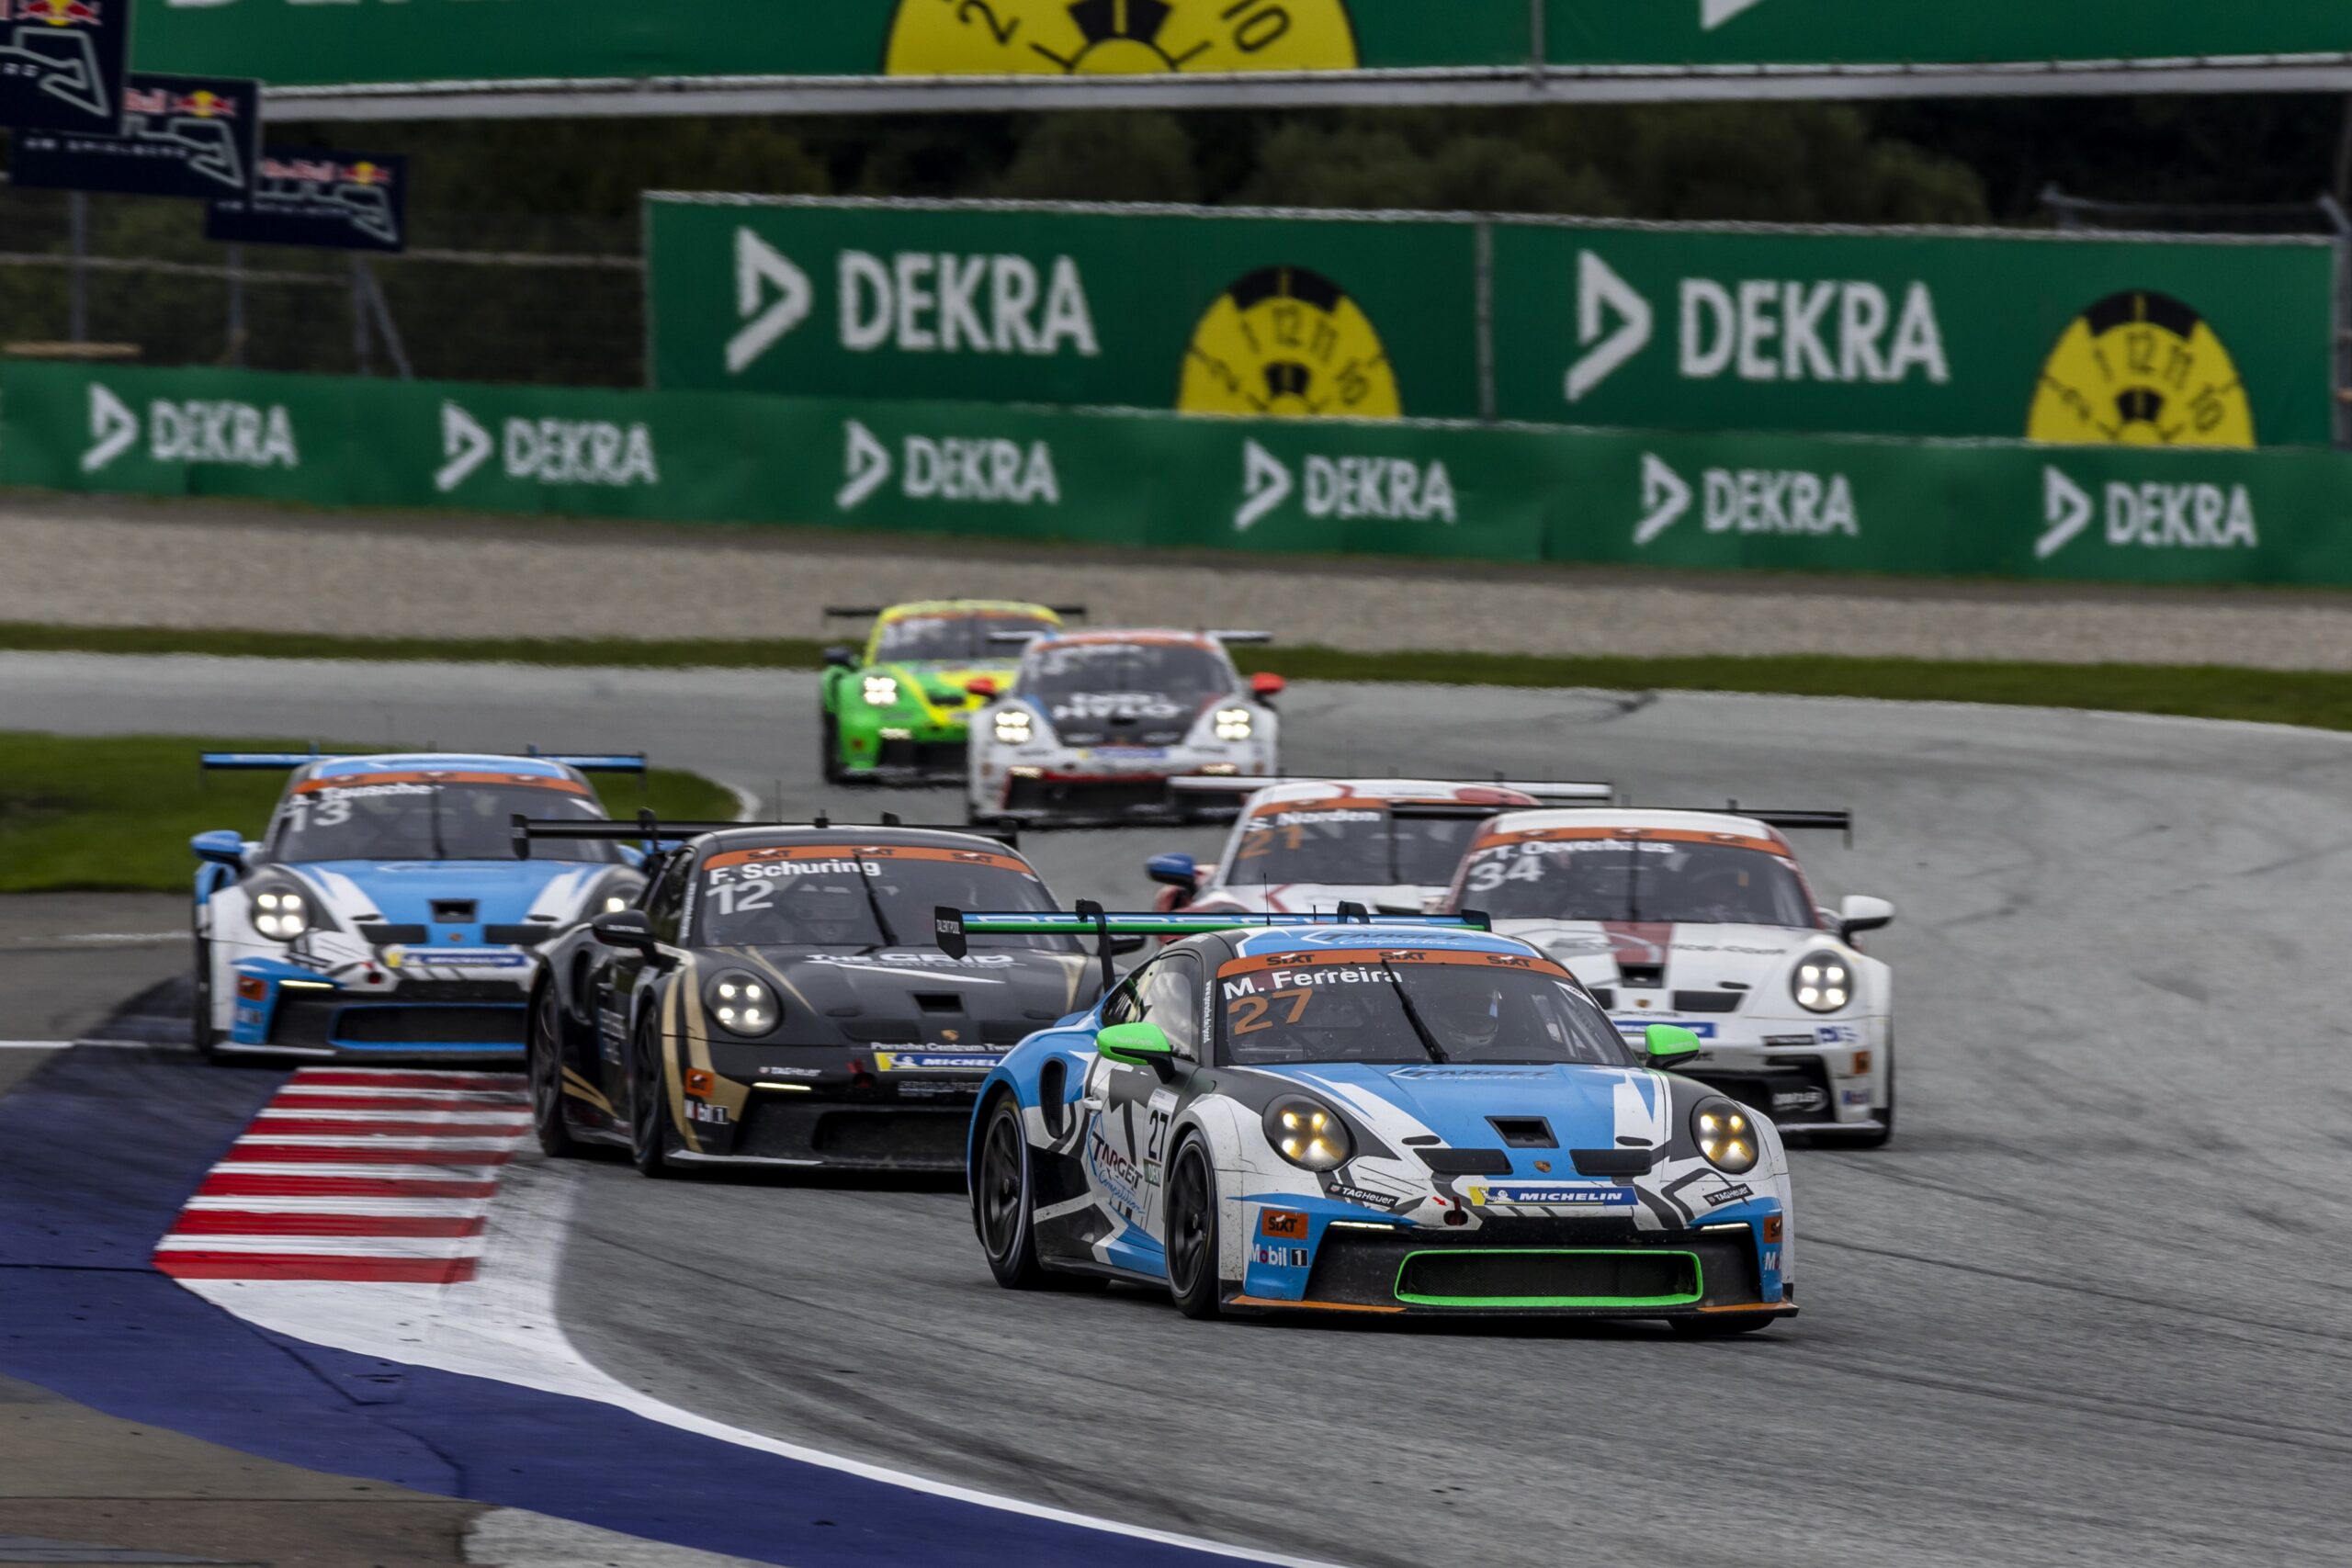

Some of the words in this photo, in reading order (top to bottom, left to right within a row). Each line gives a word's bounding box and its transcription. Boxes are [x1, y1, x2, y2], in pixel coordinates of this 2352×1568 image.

[956, 0, 1021, 45] 2
[839, 248, 1100, 356] DEKRA
[1679, 277, 1950, 383] DEKRA
[150, 398, 299, 469] DEKRA
[503, 417, 659, 487] DEKRA
[904, 434, 1059, 504] DEKRA
[1304, 455, 1457, 525] DEKRA
[1702, 469, 1859, 537] DEKRA
[2105, 482, 2256, 547] DEKRA
[281, 799, 352, 832] 13
[1239, 823, 1302, 860] 21
[709, 867, 736, 886] F.
[741, 859, 882, 879] Schuring
[1467, 854, 1545, 892] 34
[706, 879, 775, 915] 12
[1266, 953, 1316, 965] SIXT
[1378, 950, 1426, 962] SIXT
[1486, 955, 1531, 968] SIXT
[1222, 976, 1265, 1000] M.
[1272, 967, 1402, 989] Ferreira
[1227, 987, 1313, 1035] 27
[921, 1058, 997, 1066] MICHEL
[1149, 1110, 1170, 1162] 27
[1091, 1131, 1143, 1191] TARGET
[1519, 1192, 1623, 1201] MICHELIN
[1268, 1214, 1298, 1233] SIXT
[1249, 1244, 1287, 1267] Mobil
